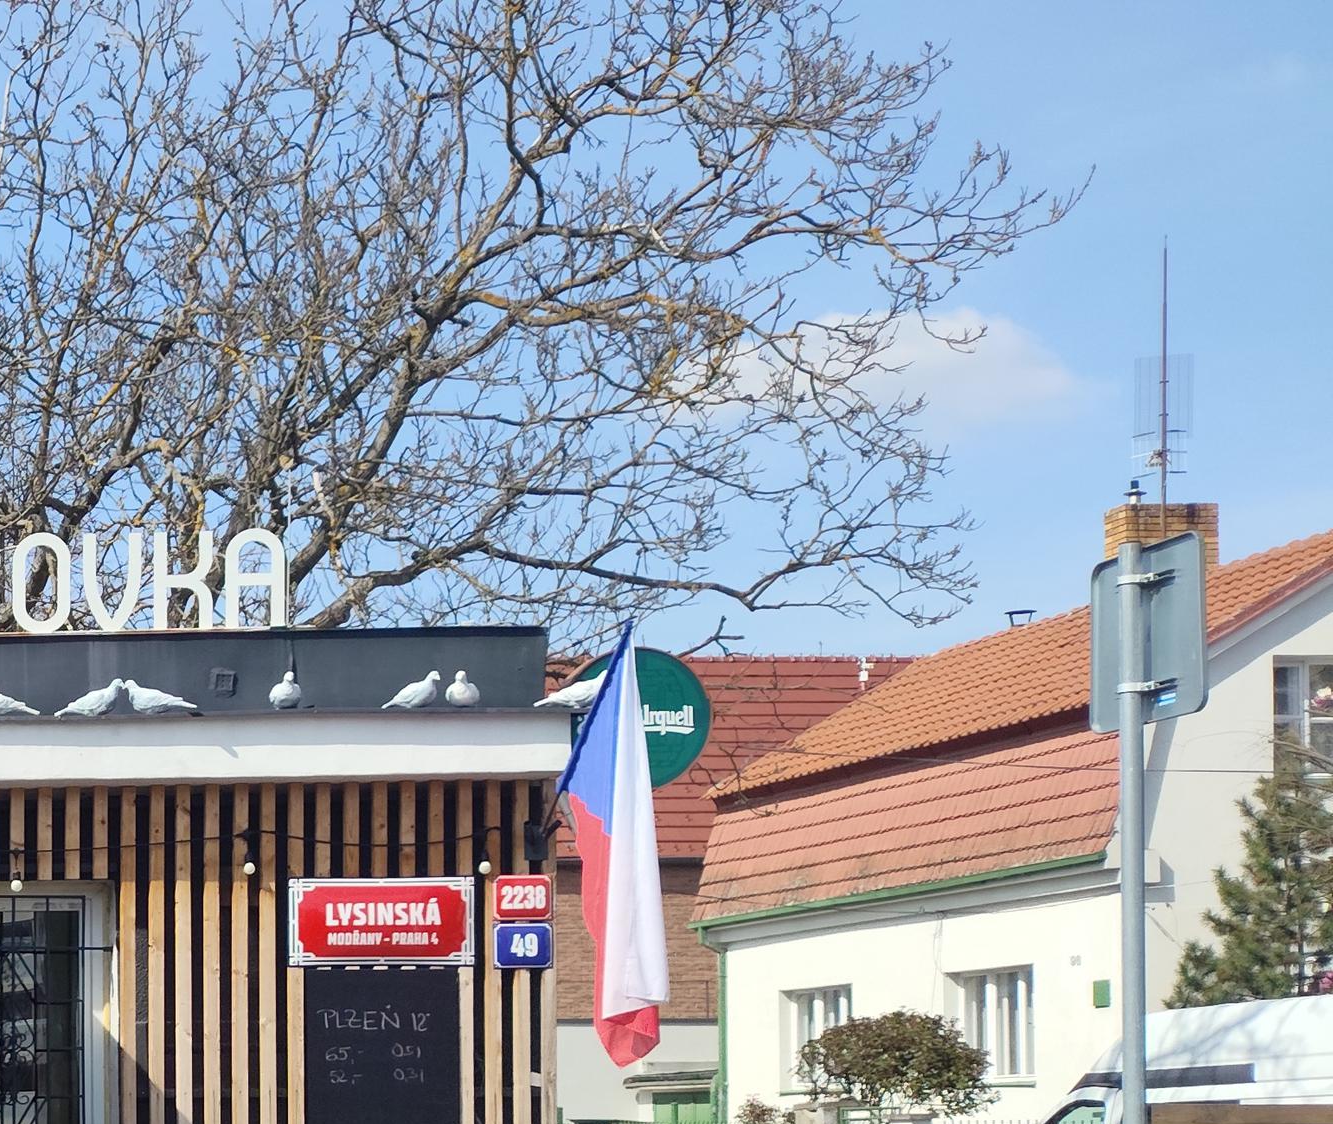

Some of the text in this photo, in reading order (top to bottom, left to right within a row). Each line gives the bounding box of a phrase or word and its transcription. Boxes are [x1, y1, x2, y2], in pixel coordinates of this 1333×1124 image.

[501, 885, 546, 909] 2238
[325, 897, 442, 926] LYSINSKÁ
[327, 930, 383, 945] MODŘANY
[391, 932, 429, 945] PRAHA
[430, 932, 439, 945] 4
[510, 934, 539, 957] 49
[317, 1004, 400, 1031] PLZEŇ
